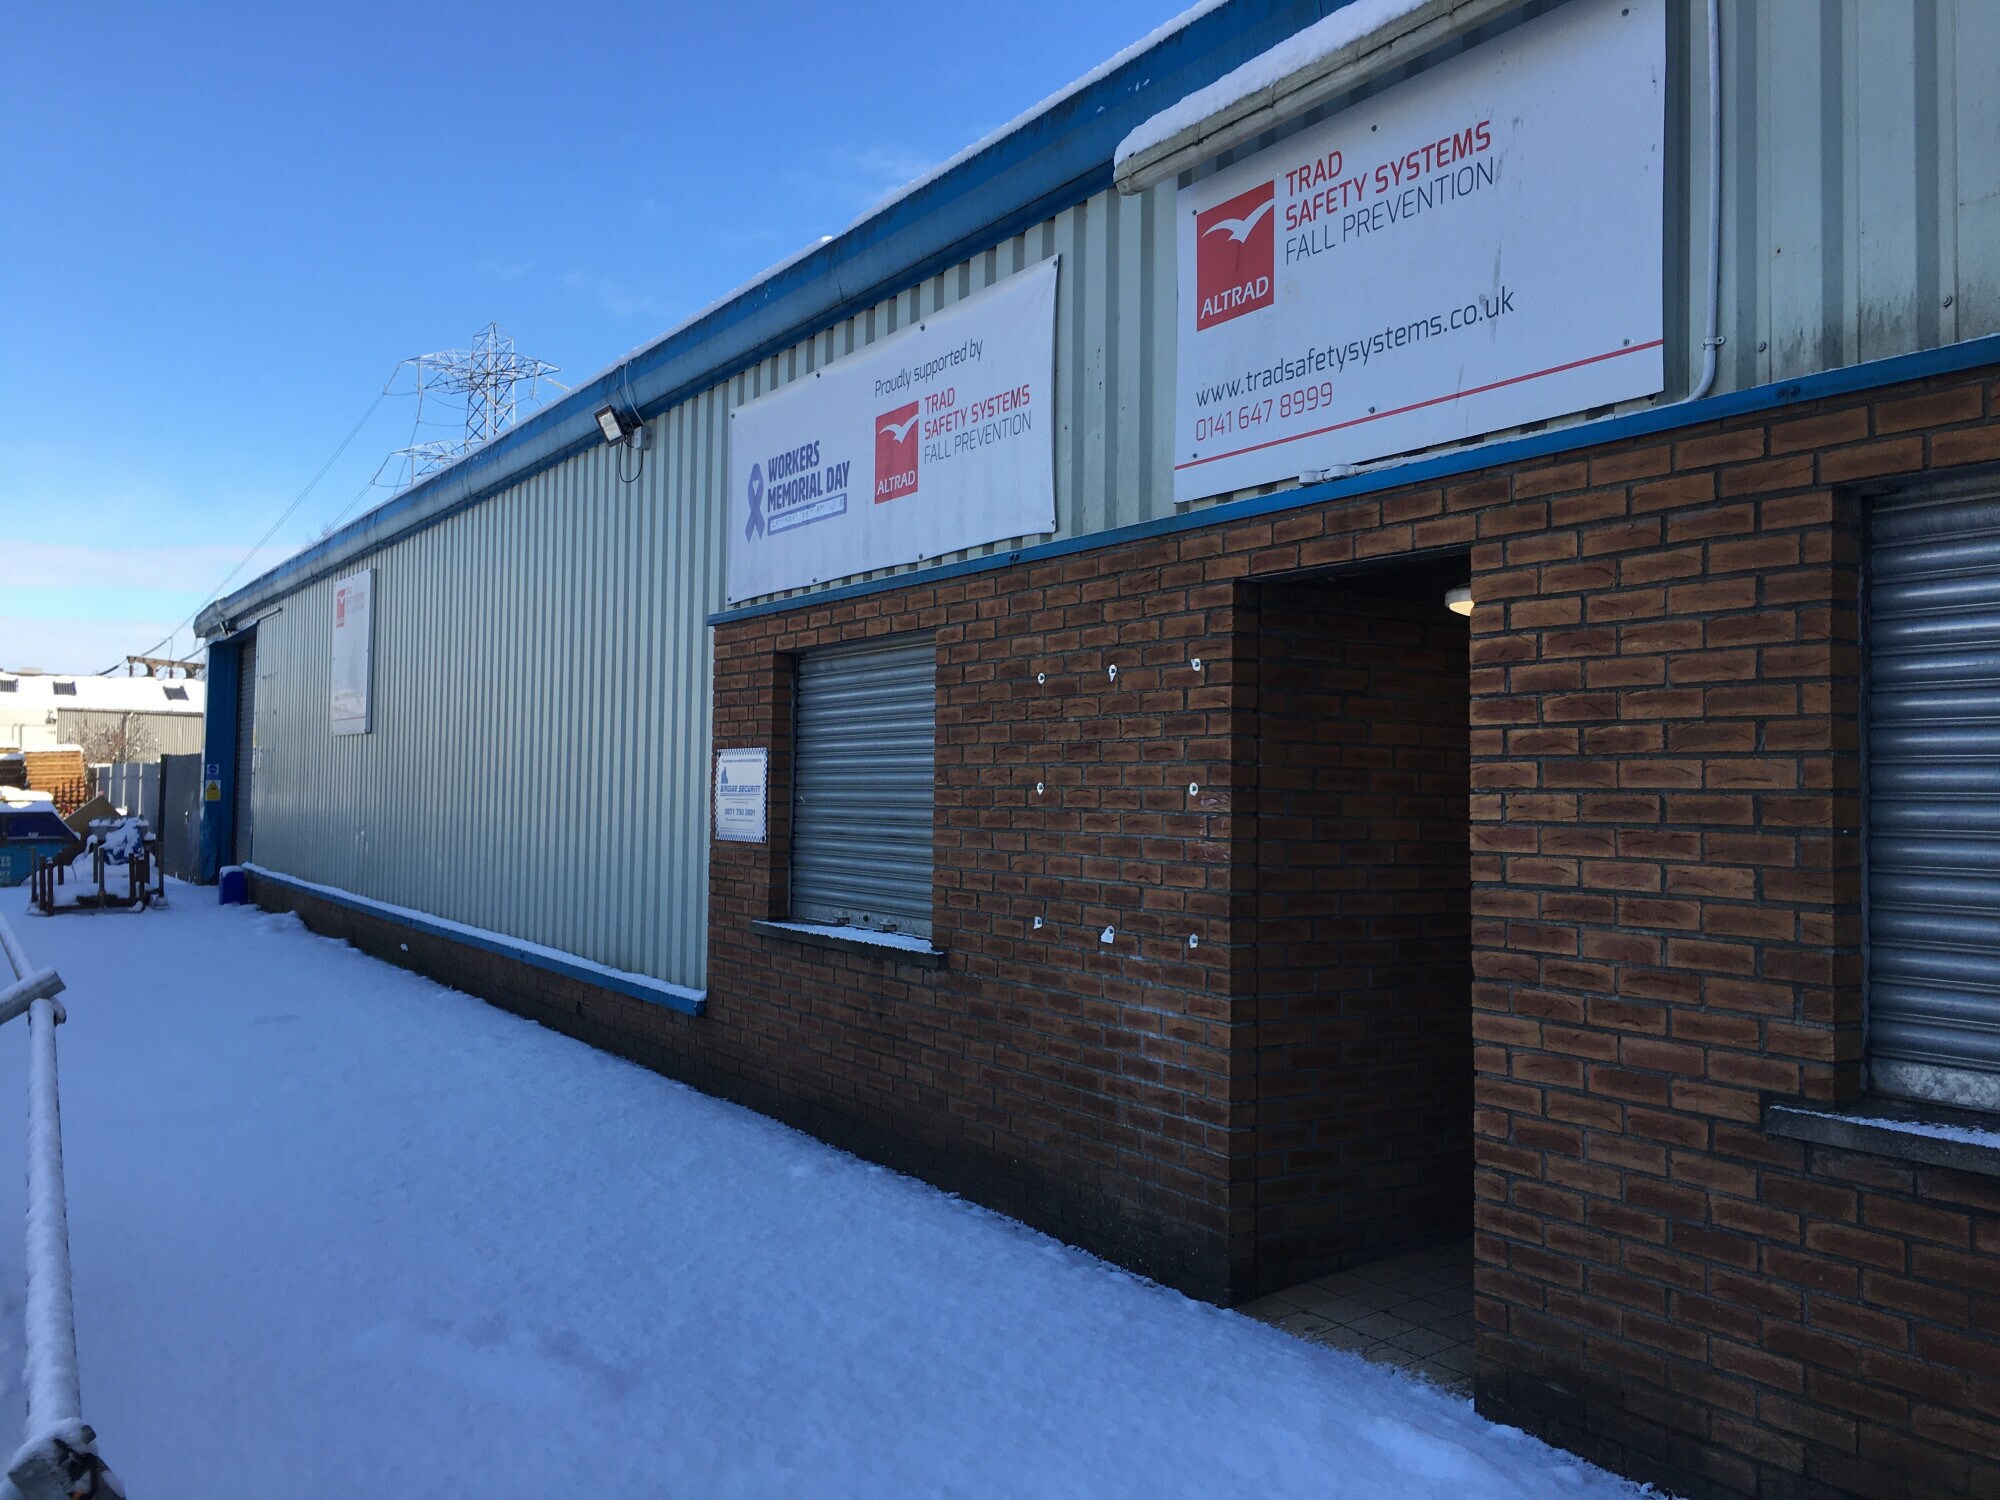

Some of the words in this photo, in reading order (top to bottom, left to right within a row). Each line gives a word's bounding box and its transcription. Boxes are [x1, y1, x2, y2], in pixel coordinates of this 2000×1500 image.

[1285, 150, 1343, 197] TRAD
[1285, 172, 1368, 232] SAFETY
[1375, 120, 1491, 194] SYSTEMS
[1285, 224, 1336, 266] FALL
[1343, 156, 1494, 242] PREVENTION
[1200, 275, 1270, 320] ALTRAD
[874, 367, 912, 399] Proudly
[913, 341, 967, 384] supported
[969, 338, 983, 362] by
[1196, 285, 1515, 408] www.tradsafetysystems.co.uk
[924, 387, 956, 416] TRAD
[924, 407, 968, 441] SAFETY
[971, 384, 1031, 424] SYSTEMS
[1195, 410, 1233, 442] 0141
[1238, 399, 1274, 430] 647
[1279, 381, 1334, 419] 8999
[768, 440, 820, 483] WORKERS
[924, 437, 952, 465] FALL
[954, 410, 1032, 456] PREVENTION
[767, 470, 824, 514] MEMORIAL
[826, 460, 851, 494] DAY
[876, 470, 916, 496] ALTRAD
